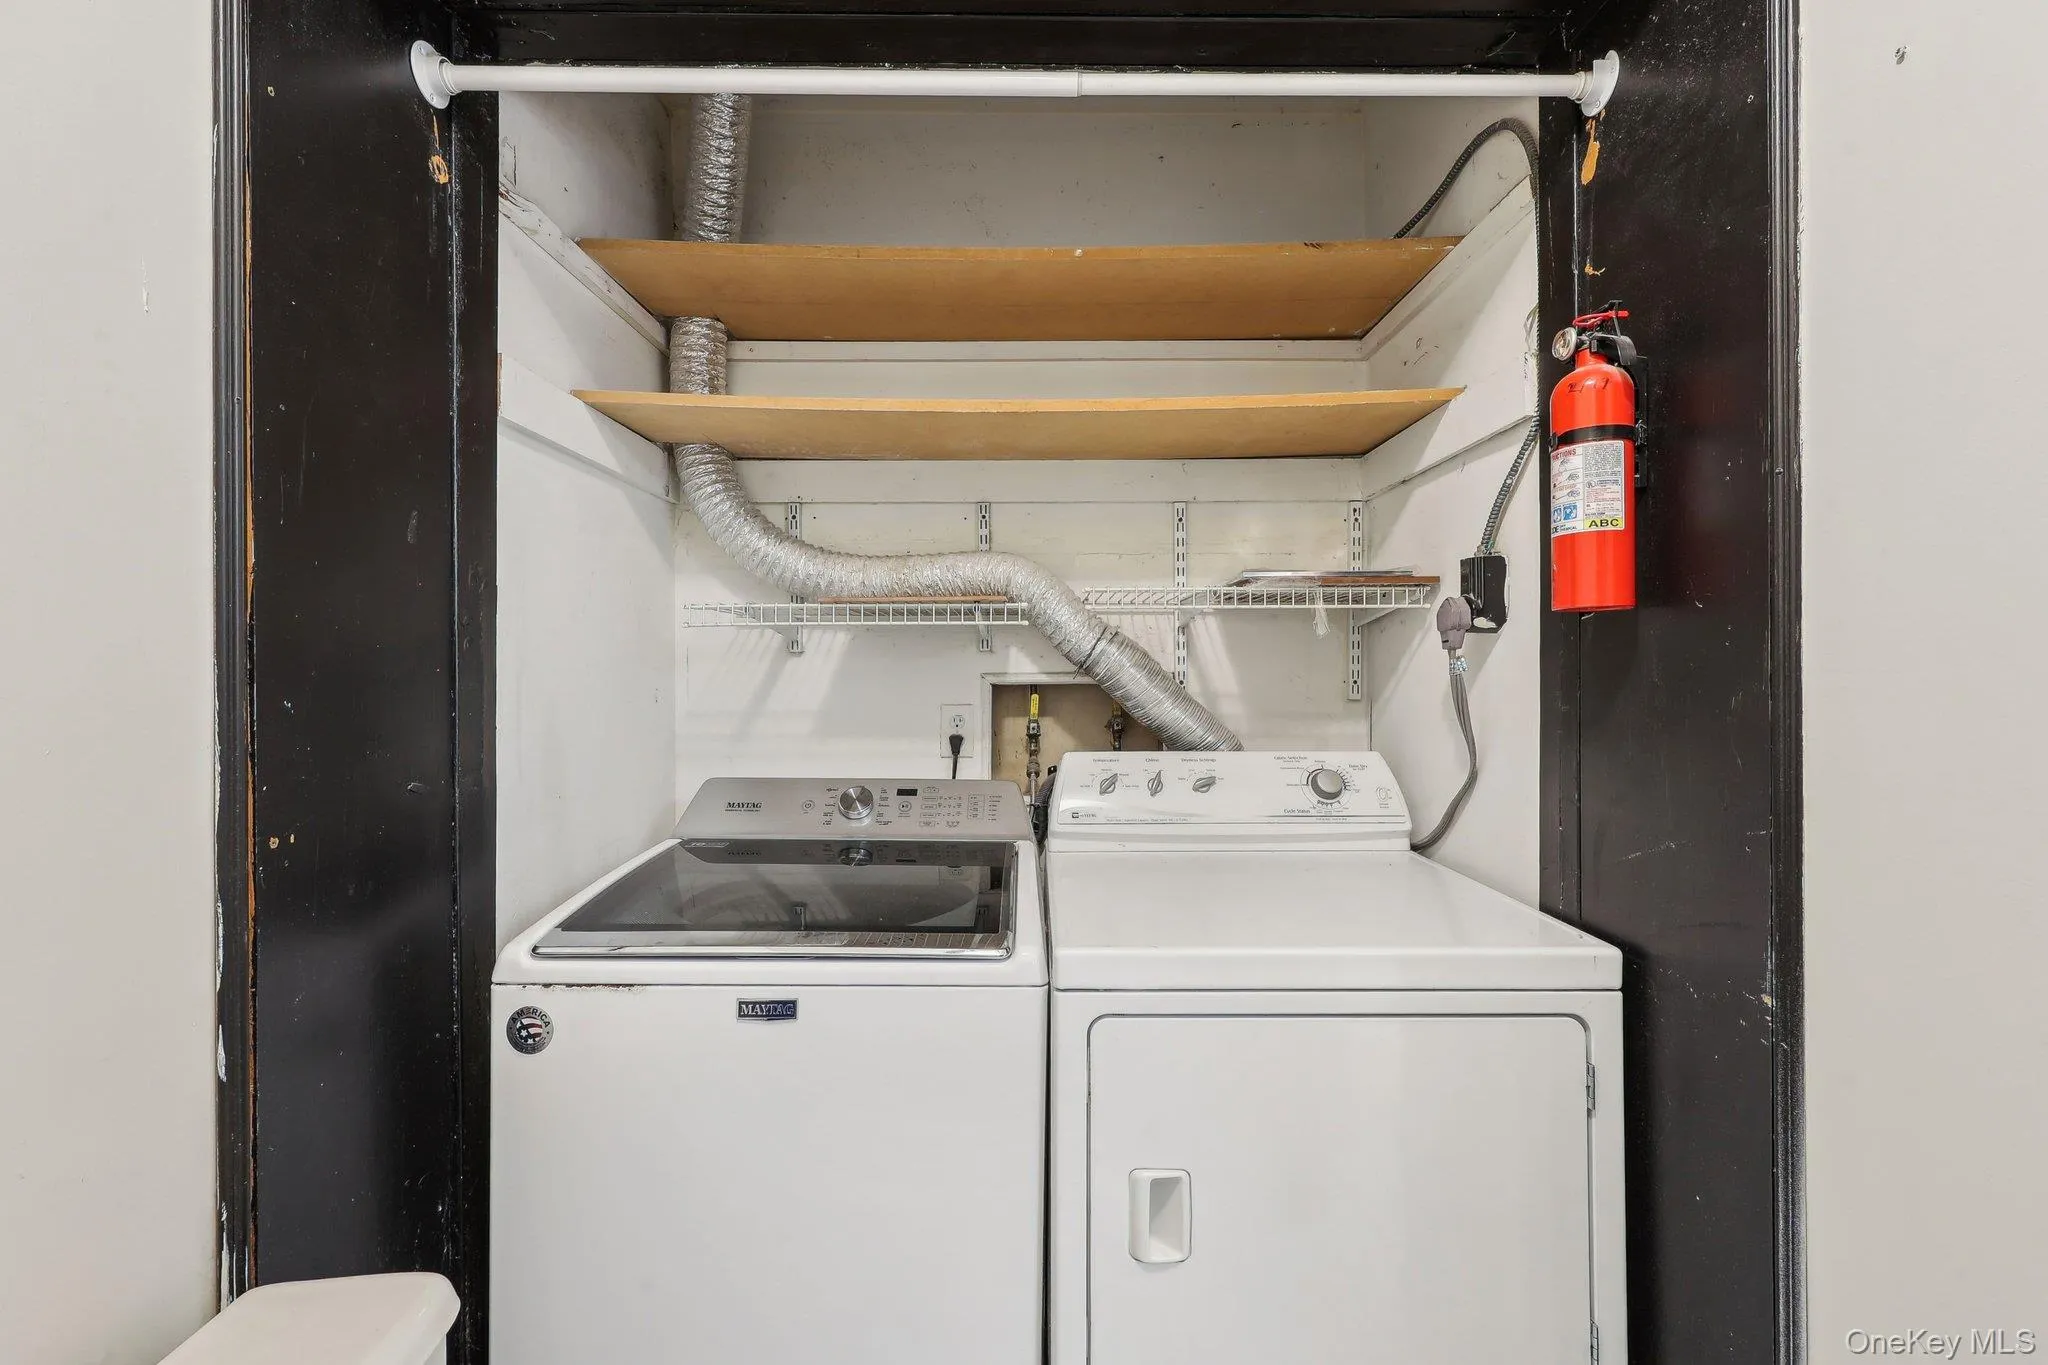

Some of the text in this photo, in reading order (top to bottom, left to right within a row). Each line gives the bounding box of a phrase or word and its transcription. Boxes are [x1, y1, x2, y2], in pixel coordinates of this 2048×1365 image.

[1588, 518, 1619, 528] ABC
[726, 801, 763, 809] MAYTAG
[740, 1003, 795, 1015] MAYTAG
[510, 1006, 551, 1029] AMERICA
